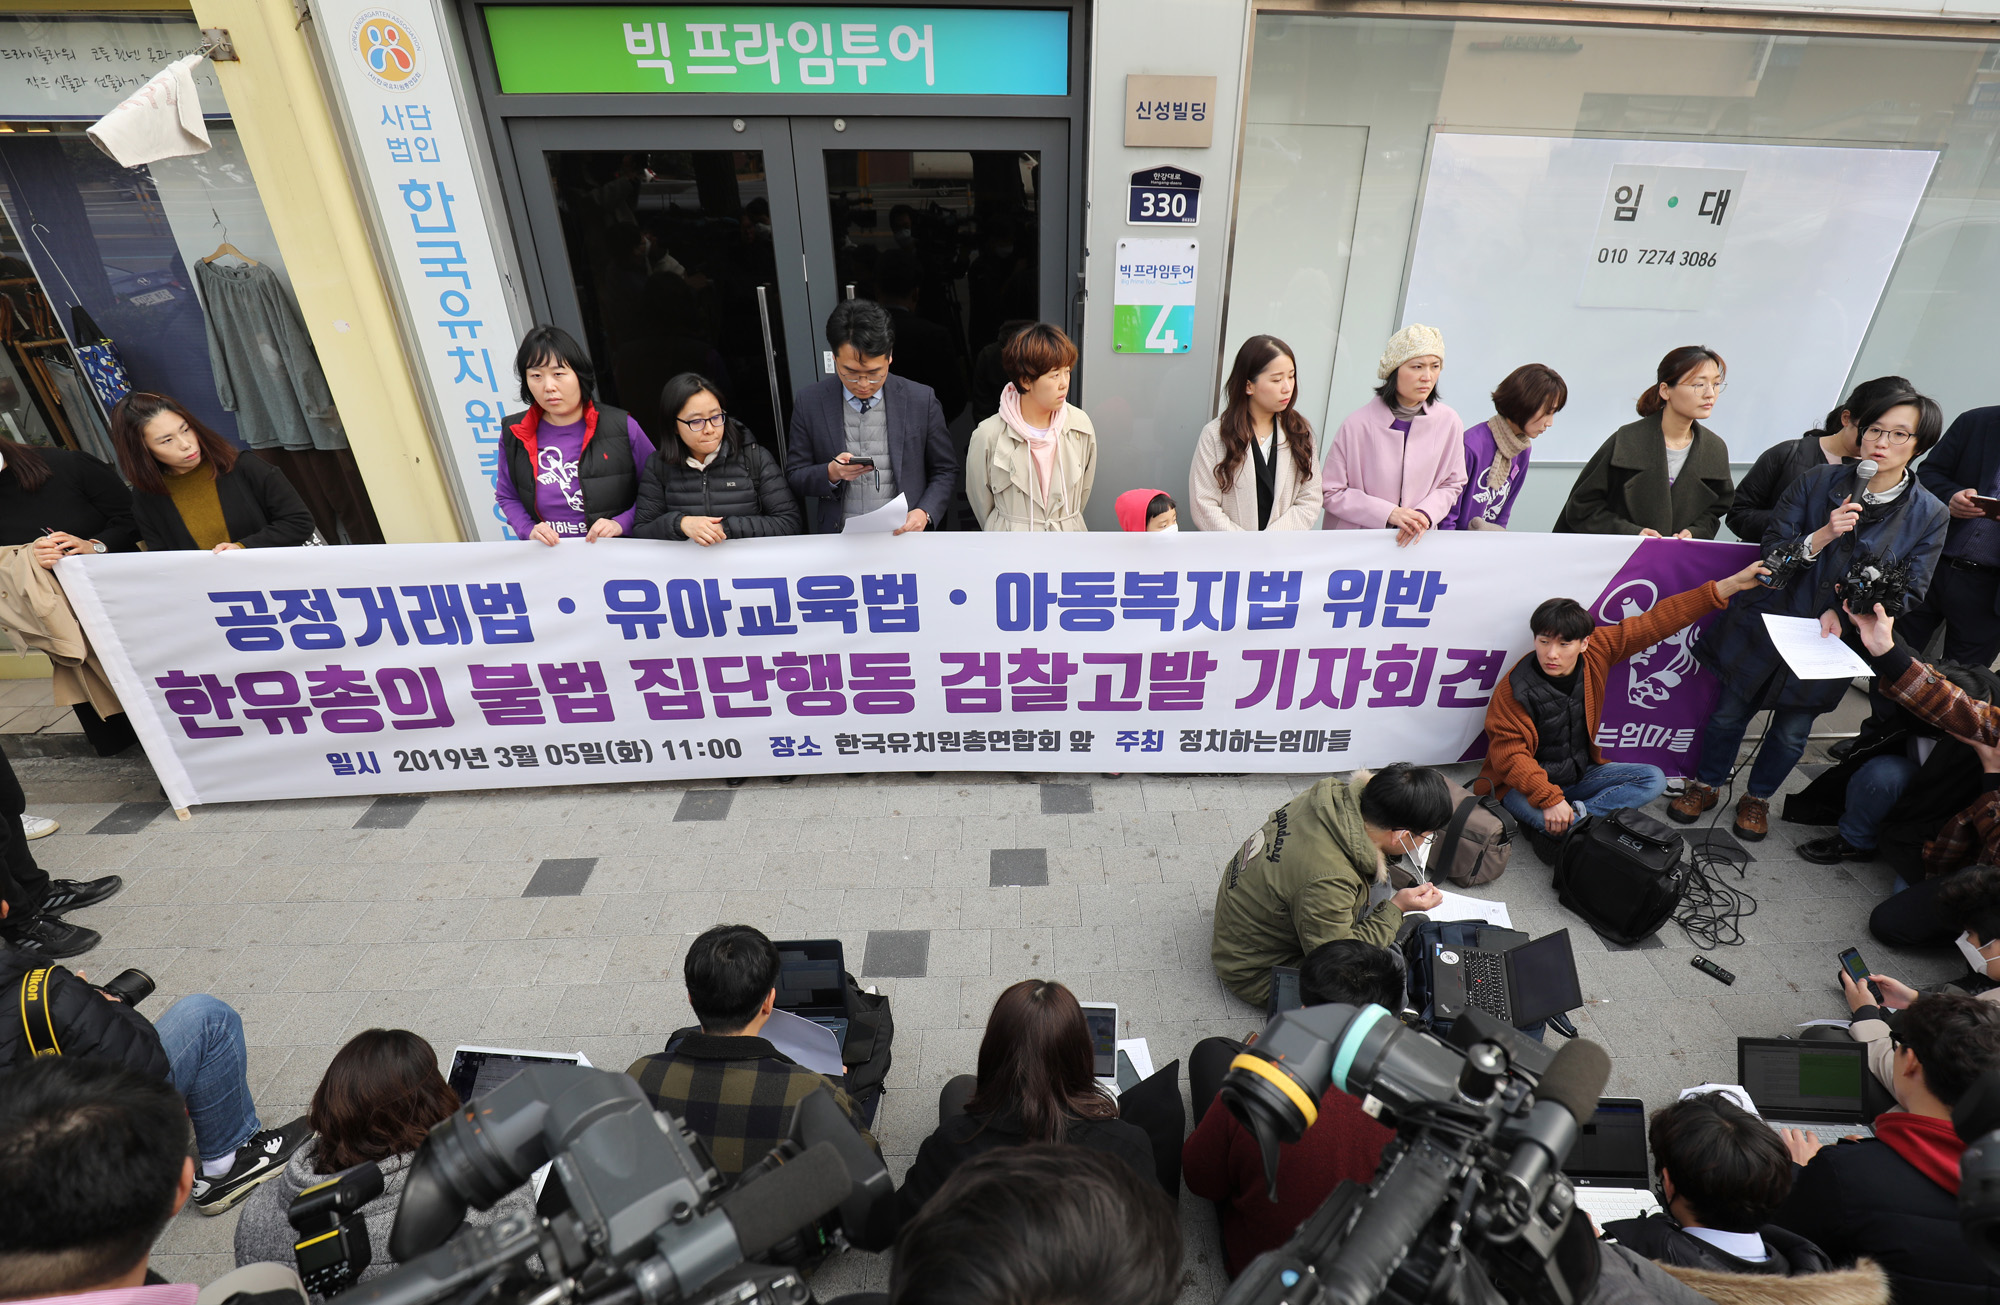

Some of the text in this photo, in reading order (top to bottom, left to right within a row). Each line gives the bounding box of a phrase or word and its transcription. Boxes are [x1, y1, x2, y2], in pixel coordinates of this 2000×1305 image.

[391, 15, 421, 52] ASSOCIATION
[1, 46, 77, 65] 드라이플라워
[147, 47, 172, 63] 옷과
[622, 21, 935, 86] 빅 프라임투어
[25, 75, 51, 89] 작은
[55, 74, 88, 93] 식물과
[94, 74, 139, 93] 선물하기
[381, 105, 432, 130] 사단
[1136, 101, 1206, 121] 신성빌딩
[386, 137, 440, 162] 법인
[1153, 172, 1181, 180] 한강대로
[1140, 192, 1187, 217] 330
[1614, 184, 1731, 225] 임 대
[1598, 248, 1717, 267] 010 7274 3086
[1120, 264, 1194, 279] 빅 프라임투어
[1145, 305, 1178, 354] 4
[207, 569, 1447, 652] 공정거래법 유아교육법 아동복지법 위반
[155, 643, 1506, 739] 한유총의 불법 집단행동 검찰고발 기자회견
[326, 728, 1351, 776] 일시 2019년 3월 05일(화) 11:00 장소 한국유치원총연합회 앞 주최 정치하는엄마들
[27, 968, 47, 1001] Nikon
